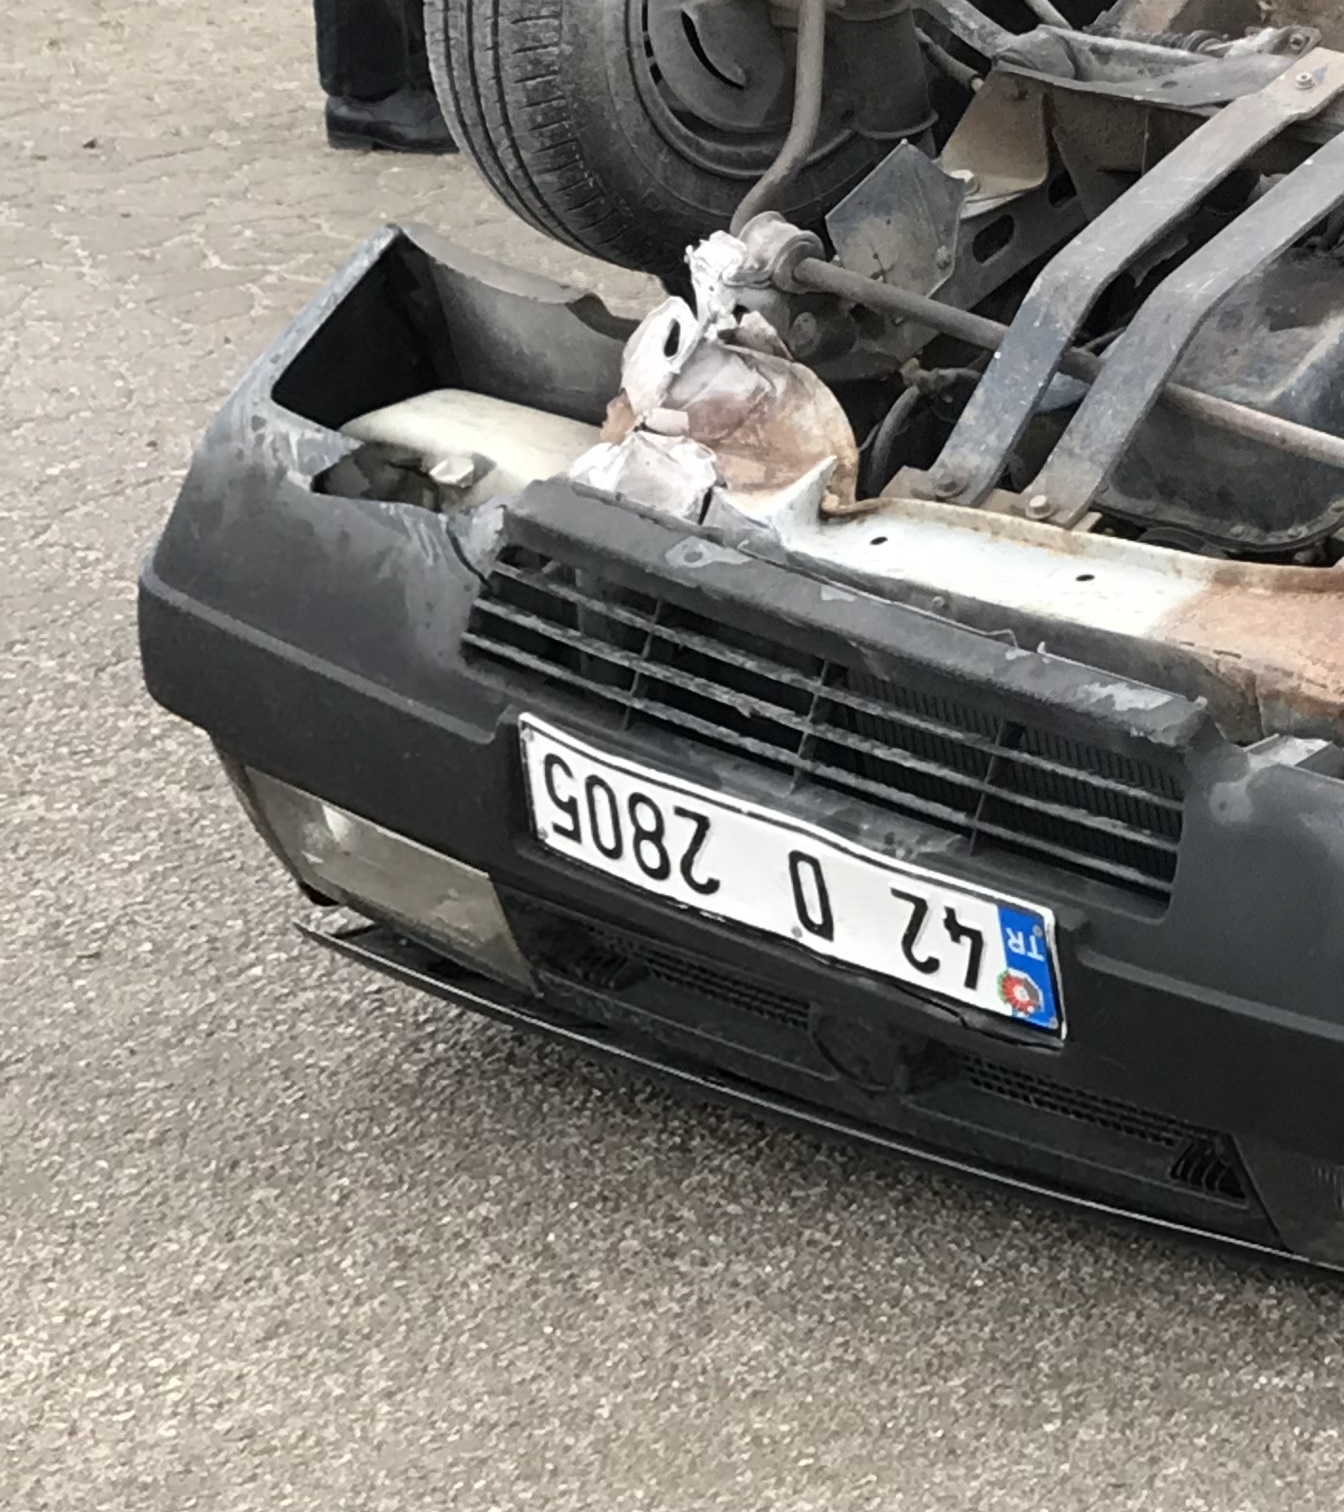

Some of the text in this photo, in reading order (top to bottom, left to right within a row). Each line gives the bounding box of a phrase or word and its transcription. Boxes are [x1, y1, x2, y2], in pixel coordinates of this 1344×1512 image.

[543, 751, 722, 896] 2805
[890, 886, 985, 990] 42
[1005, 927, 1046, 963] TR
